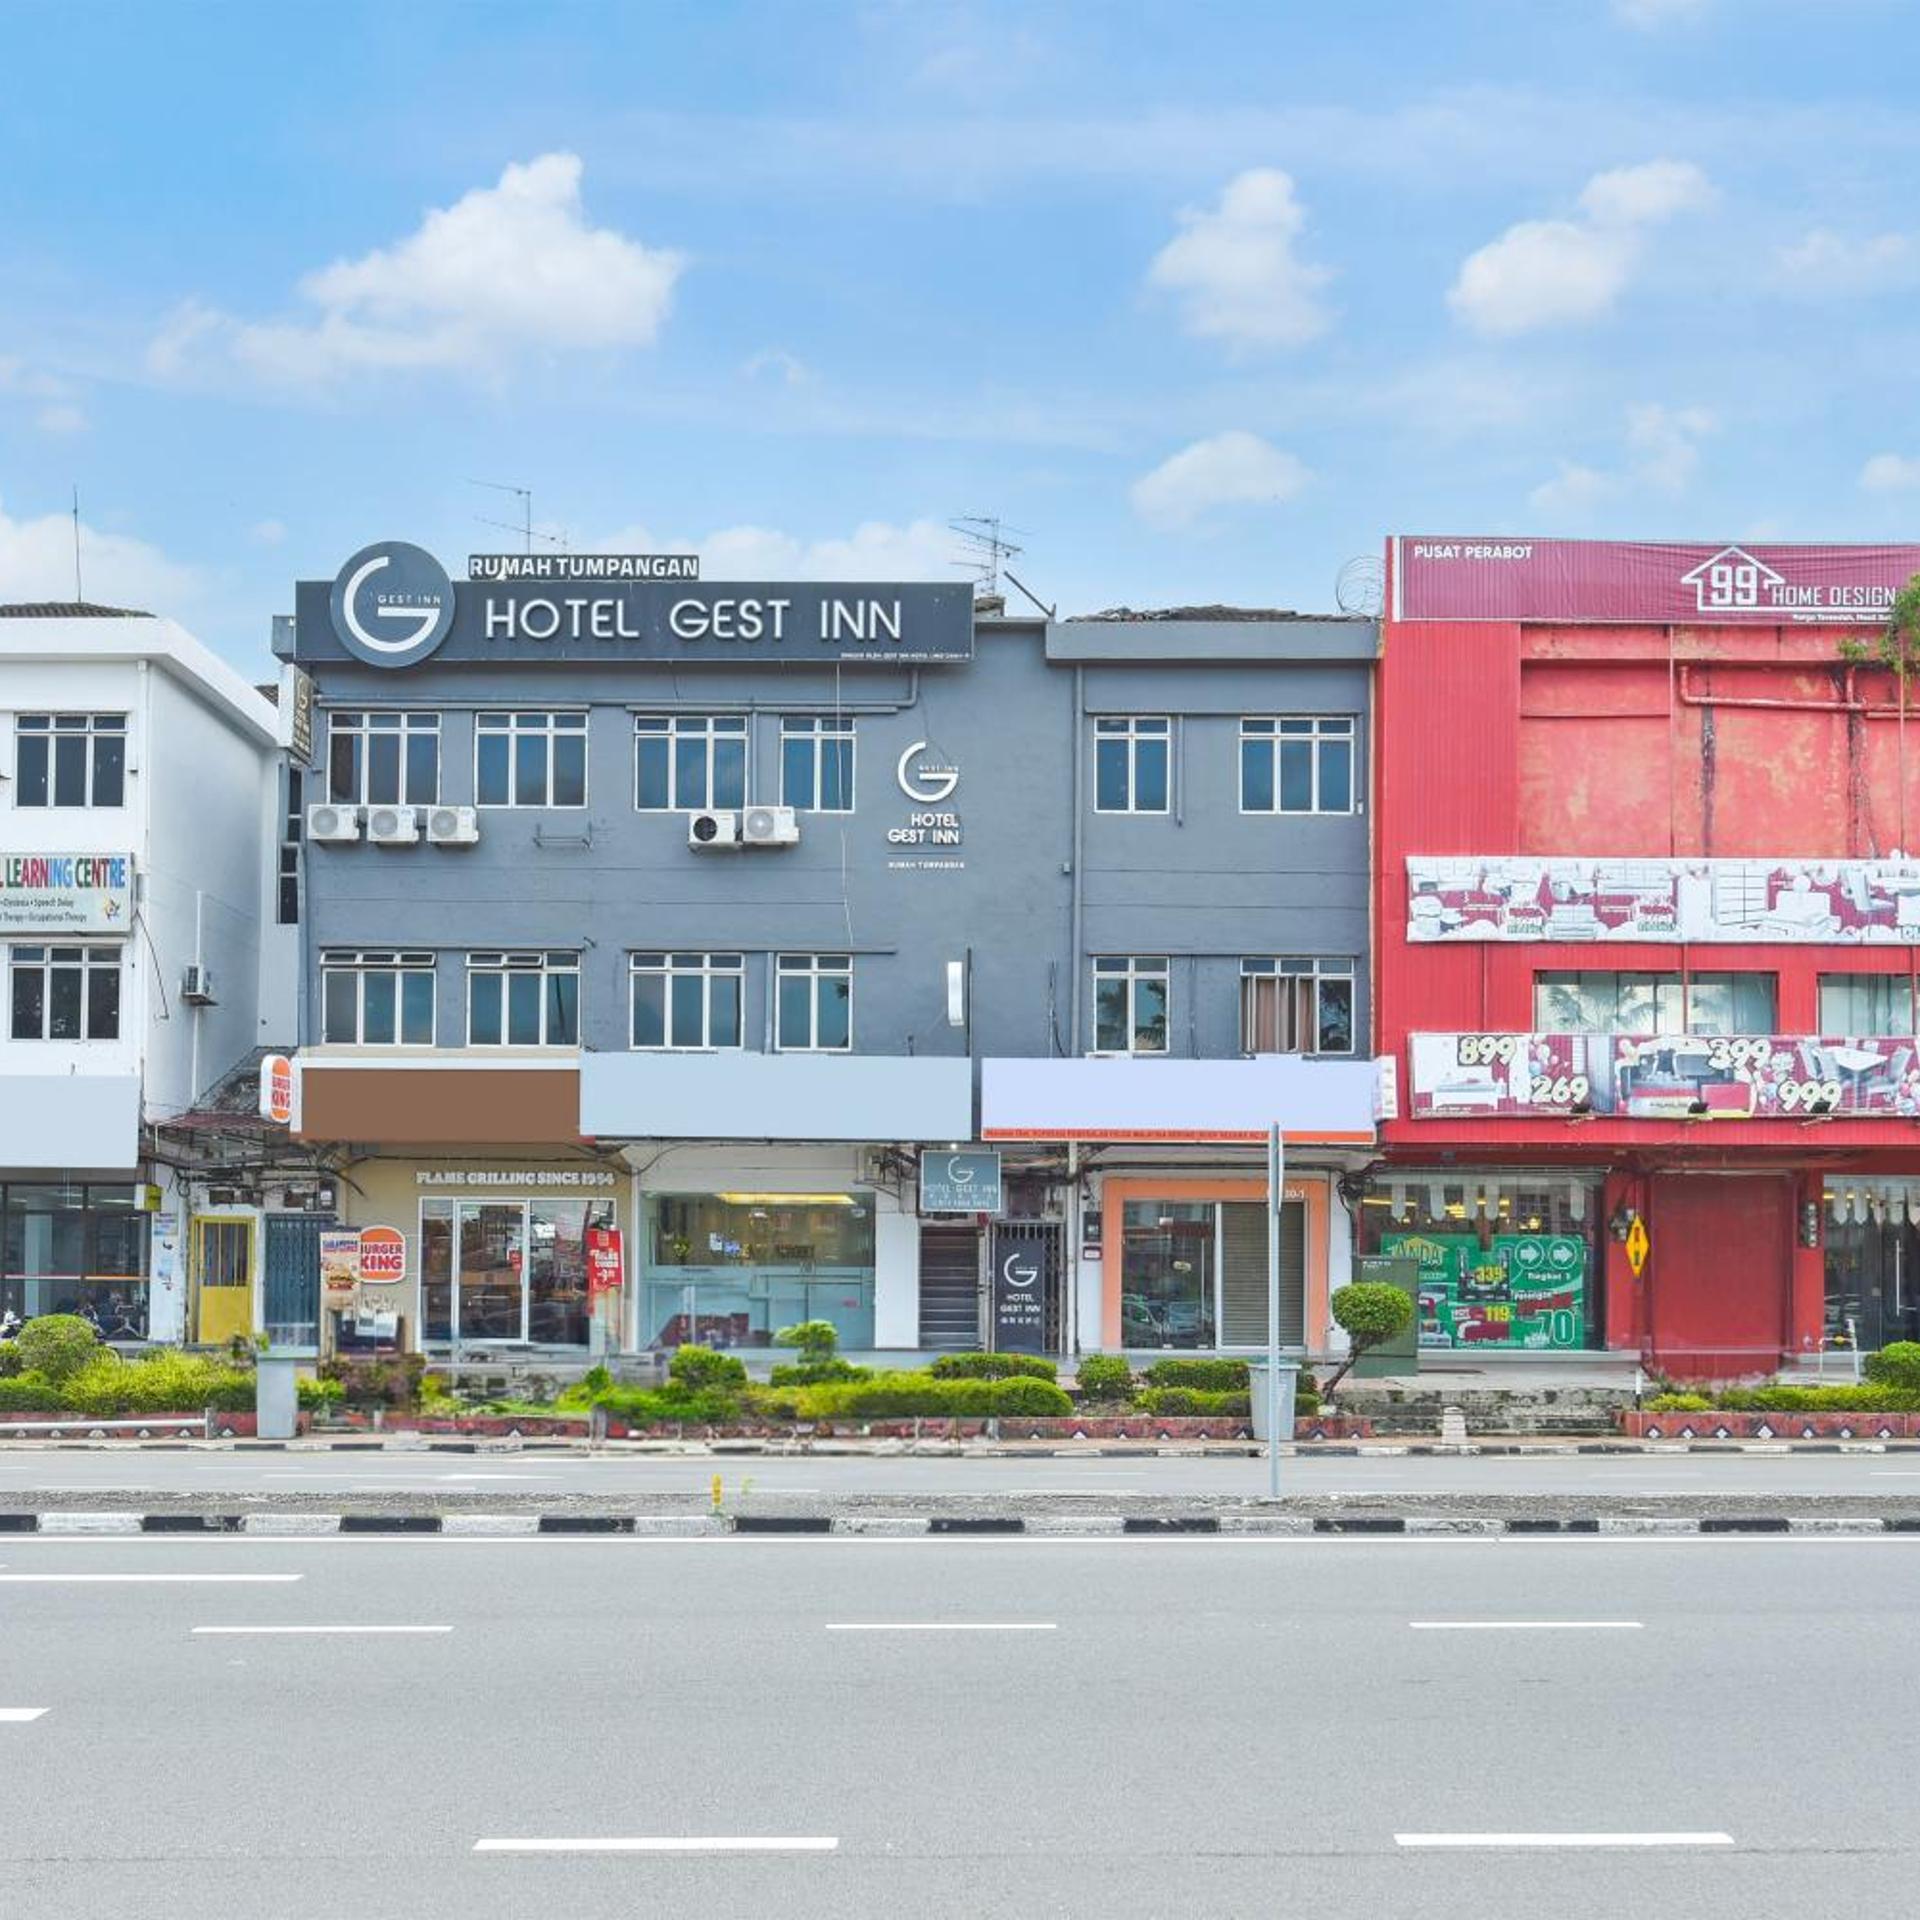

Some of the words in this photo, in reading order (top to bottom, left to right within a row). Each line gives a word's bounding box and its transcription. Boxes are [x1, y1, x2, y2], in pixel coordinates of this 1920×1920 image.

[1414, 545, 1461, 558] PUSAT
[1465, 546, 1532, 559] PERABOT
[469, 558, 551, 577] RUMAH
[556, 558, 698, 577] TUMPANGAN
[1711, 566, 1757, 605] 99
[1772, 587, 1822, 606] HOME
[1829, 587, 1897, 606] DESIGN
[486, 599, 640, 638] HOTEL
[669, 599, 791, 639] GEST
[820, 600, 901, 639] INN
[911, 813, 959, 827] HOTEL
[888, 829, 926, 844] GEST
[932, 829, 959, 845] INN
[6, 857, 73, 888] LEARNING
[75, 857, 126, 888] CENTRE
[1459, 1036, 1517, 1064] 899
[1707, 1038, 1771, 1070] 399
[1532, 1075, 1590, 1104] 269
[1779, 1080, 1842, 1113] 999
[416, 1172, 465, 1184] FLAME
[467, 1172, 536, 1185] GRILLING
[537, 1172, 580, 1184] SINCE
[581, 1173, 614, 1185] 1954
[361, 1256, 403, 1270] KING
[1006, 1293, 1034, 1302] HOTEL
[1486, 1305, 1510, 1322] 119
